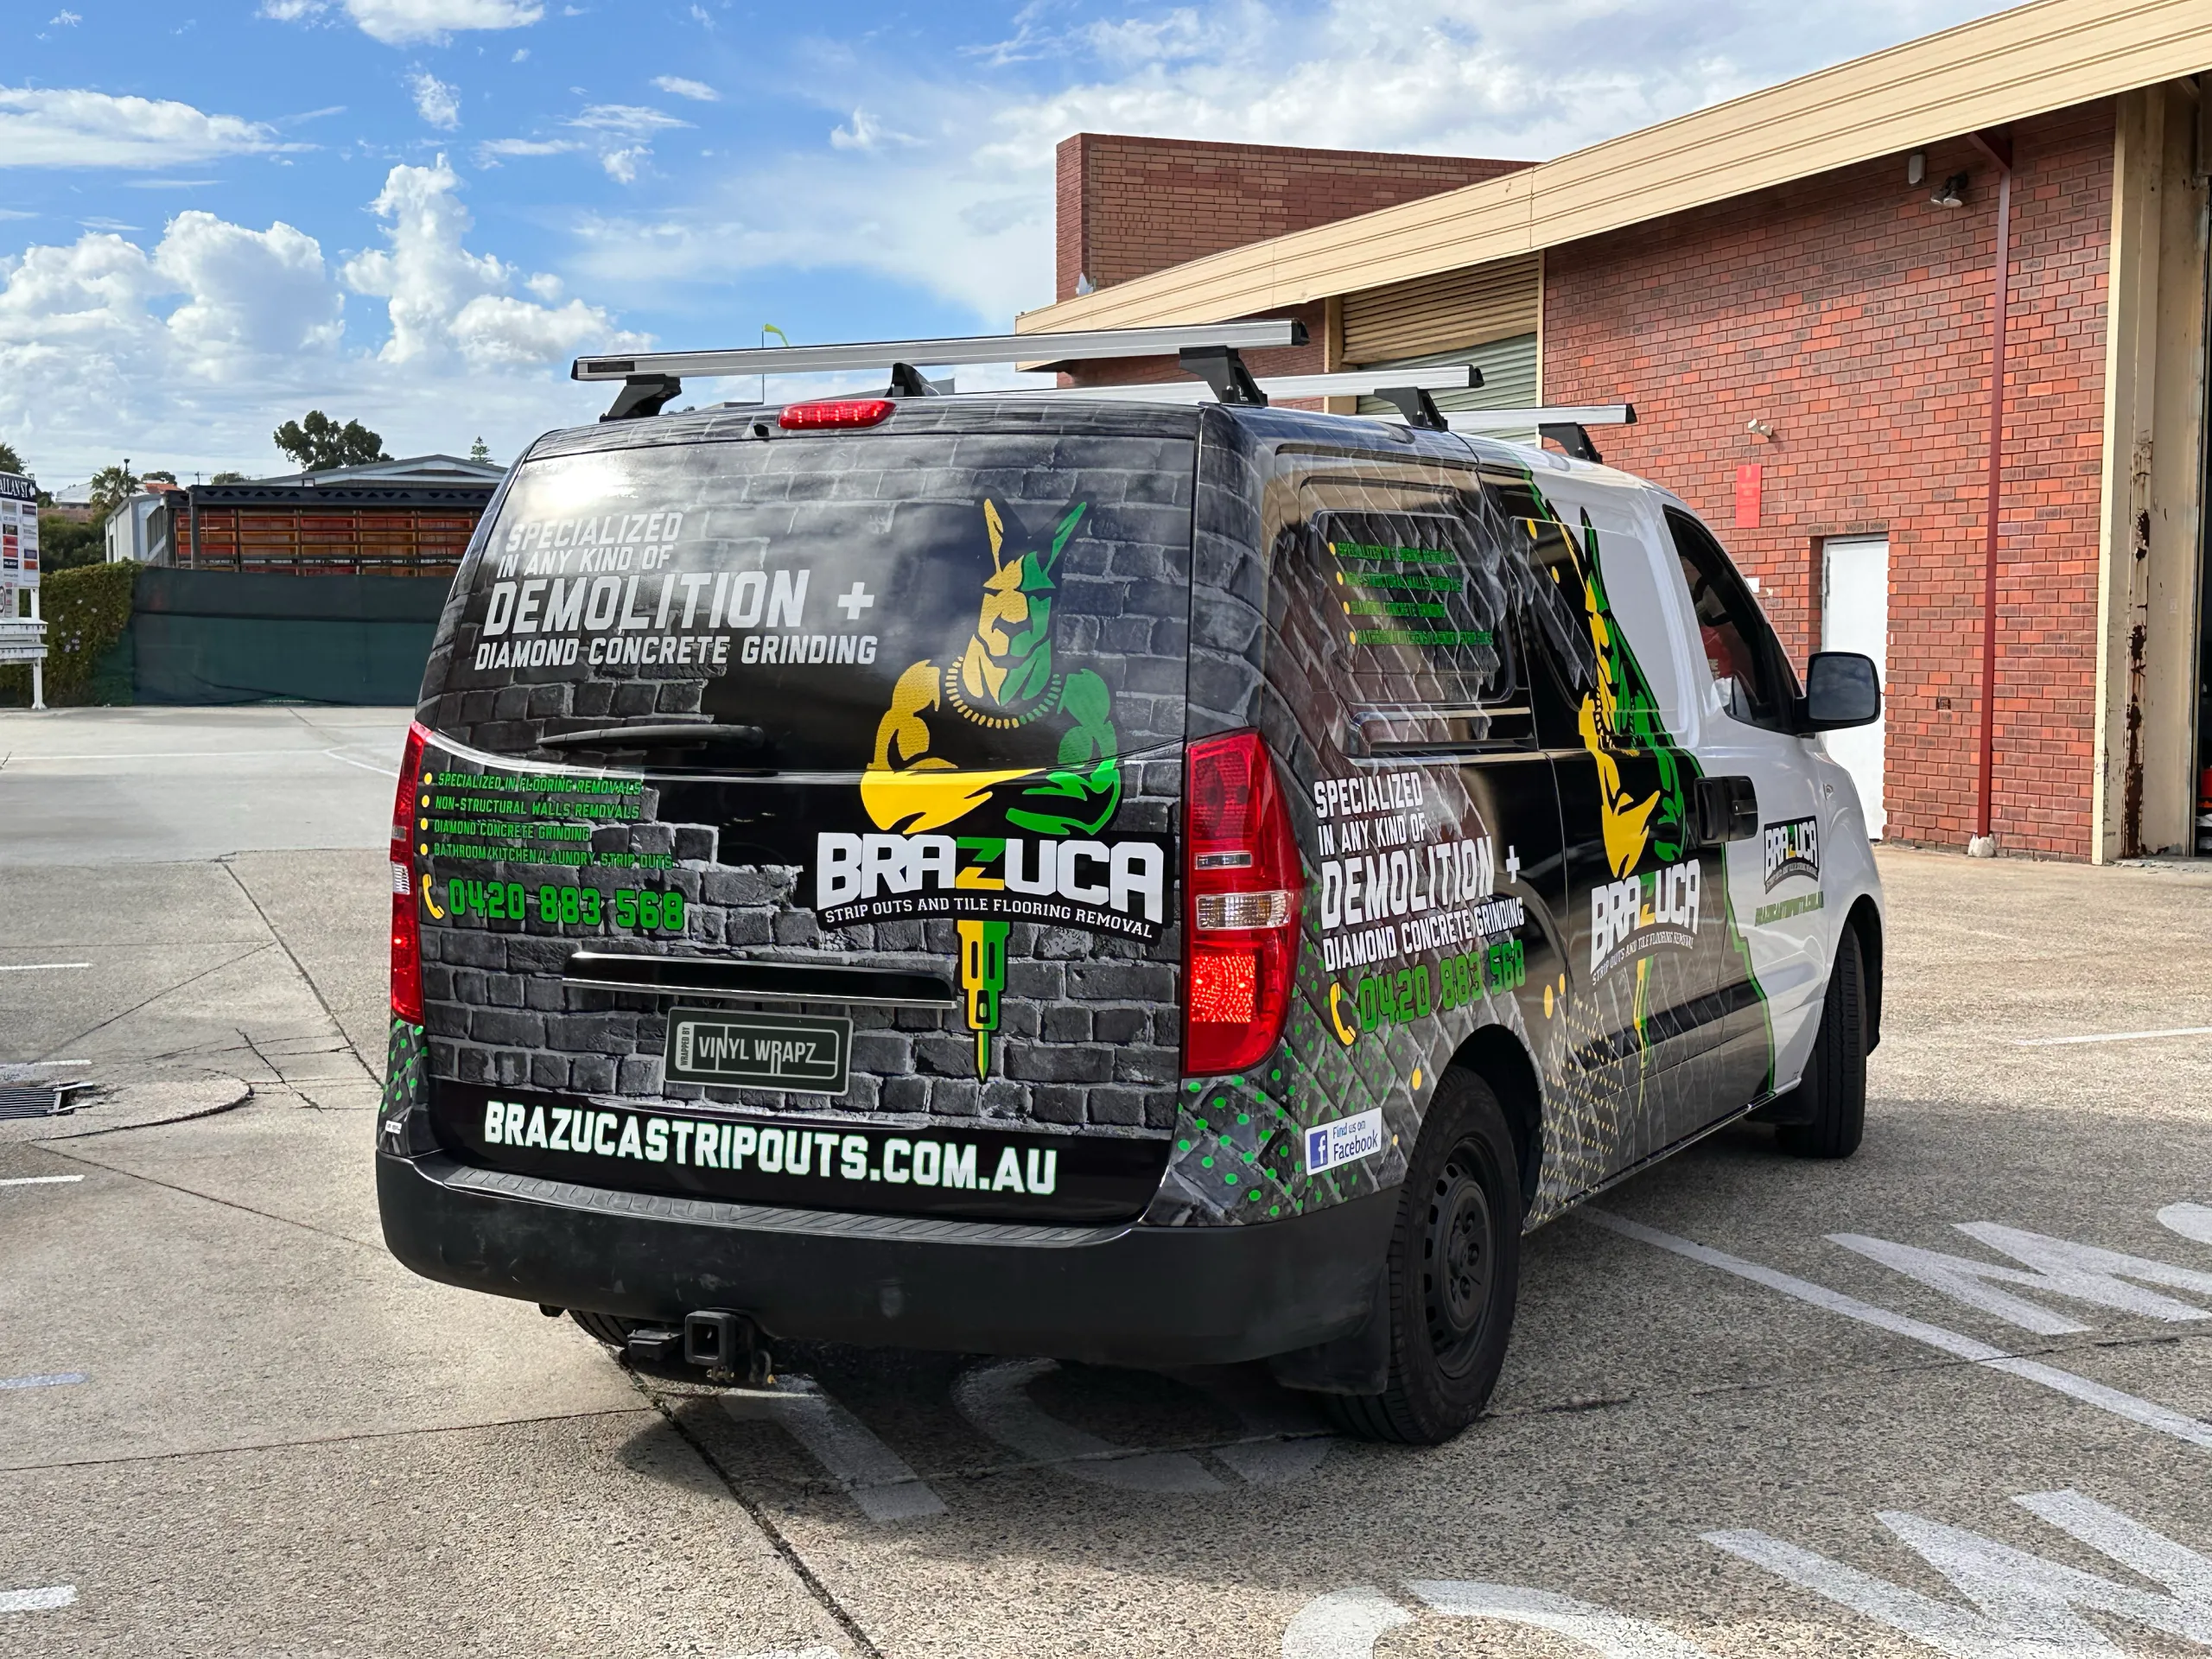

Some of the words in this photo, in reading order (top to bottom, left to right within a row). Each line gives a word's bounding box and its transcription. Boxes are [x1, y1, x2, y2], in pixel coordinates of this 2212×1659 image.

[505, 512, 683, 552] SPECIALIZED
[497, 554, 519, 579] IN
[524, 550, 571, 576] ANY
[579, 546, 633, 574] KIND
[640, 545, 673, 569] OF
[482, 570, 810, 637] DEMOLITION
[474, 638, 580, 671] DIAMOND
[588, 636, 729, 664] CONCRETE
[741, 636, 878, 664] GRINDING
[438, 772, 501, 790] SPECIALIZED
[505, 777, 516, 790] IN
[518, 777, 573, 792] FLOORING
[576, 779, 642, 795] REMOVALS
[1313, 772, 1424, 818] SPECIALIZED
[435, 795, 527, 815] NON-STRUCTURAL
[532, 800, 570, 817] WALLS
[575, 804, 640, 819] REMOVALS
[434, 819, 476, 836] DIAMOND
[480, 822, 534, 839] CONCRETE
[538, 824, 589, 841] GRINDING
[1318, 823, 1335, 856] IN
[1341, 819, 1370, 854] ANY
[1374, 815, 1407, 848] KIND
[1410, 812, 1426, 842] OF
[601, 853, 635, 868] STRIP
[639, 855, 673, 869] OUTS
[1764, 821, 1818, 882] BRAZUCA
[817, 832, 1164, 924] BRAZUCA
[1320, 836, 1494, 930] DEMOLITION
[448, 878, 525, 920] 0420
[539, 885, 602, 926] 883
[614, 888, 685, 931] 568
[824, 904, 868, 923] STRIP
[873, 899, 912, 915] OUTS
[918, 898, 950, 911] AND
[953, 898, 988, 911] TILE
[993, 899, 1071, 919] FLOORING
[1075, 908, 1153, 938] REMOVAL
[1590, 858, 1700, 975] BRAZUCA
[1323, 925, 1397, 972] DIAMOND
[1402, 909, 1472, 954] CONCRETE
[1474, 896, 1524, 937] GRINDING
[1357, 964, 1431, 1033] 0420
[1440, 951, 1485, 1011] 883
[1488, 939, 1526, 994] 568
[682, 1027, 690, 1035] BY
[698, 1033, 750, 1063] VINYL
[754, 1039, 819, 1068] WRAPZ
[680, 1037, 690, 1066] WRAPPED
[484, 1102, 1058, 1194] BRAZUCASTRIPOUTS.COM.AU
[1332, 1122, 1348, 1140] Find
[1348, 1122, 1357, 1135] us
[1357, 1121, 1366, 1131] on
[1333, 1129, 1378, 1161] Facebook
